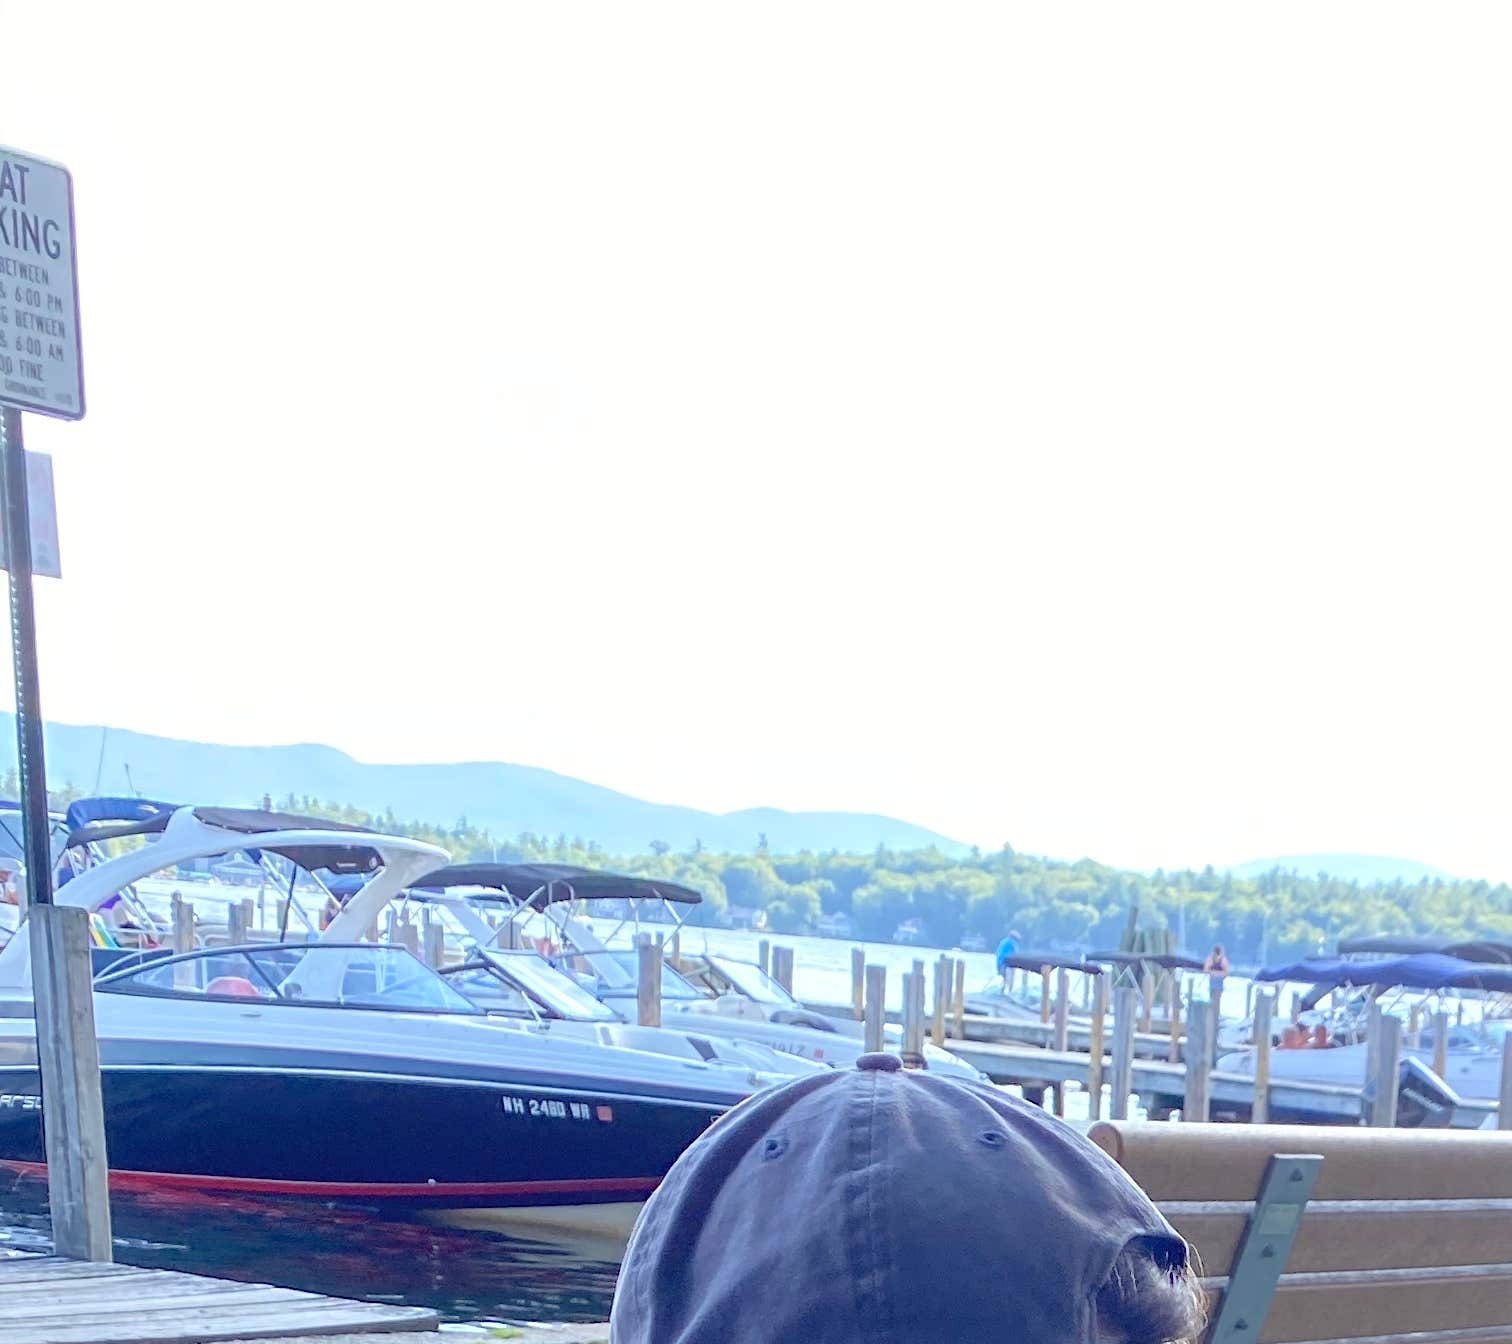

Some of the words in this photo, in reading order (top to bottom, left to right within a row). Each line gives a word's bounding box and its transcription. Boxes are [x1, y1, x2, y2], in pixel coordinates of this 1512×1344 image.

[0, 160, 30, 206] AT
[15, 309, 66, 339] BETWEEN
[502, 1095, 524, 1115] NH
